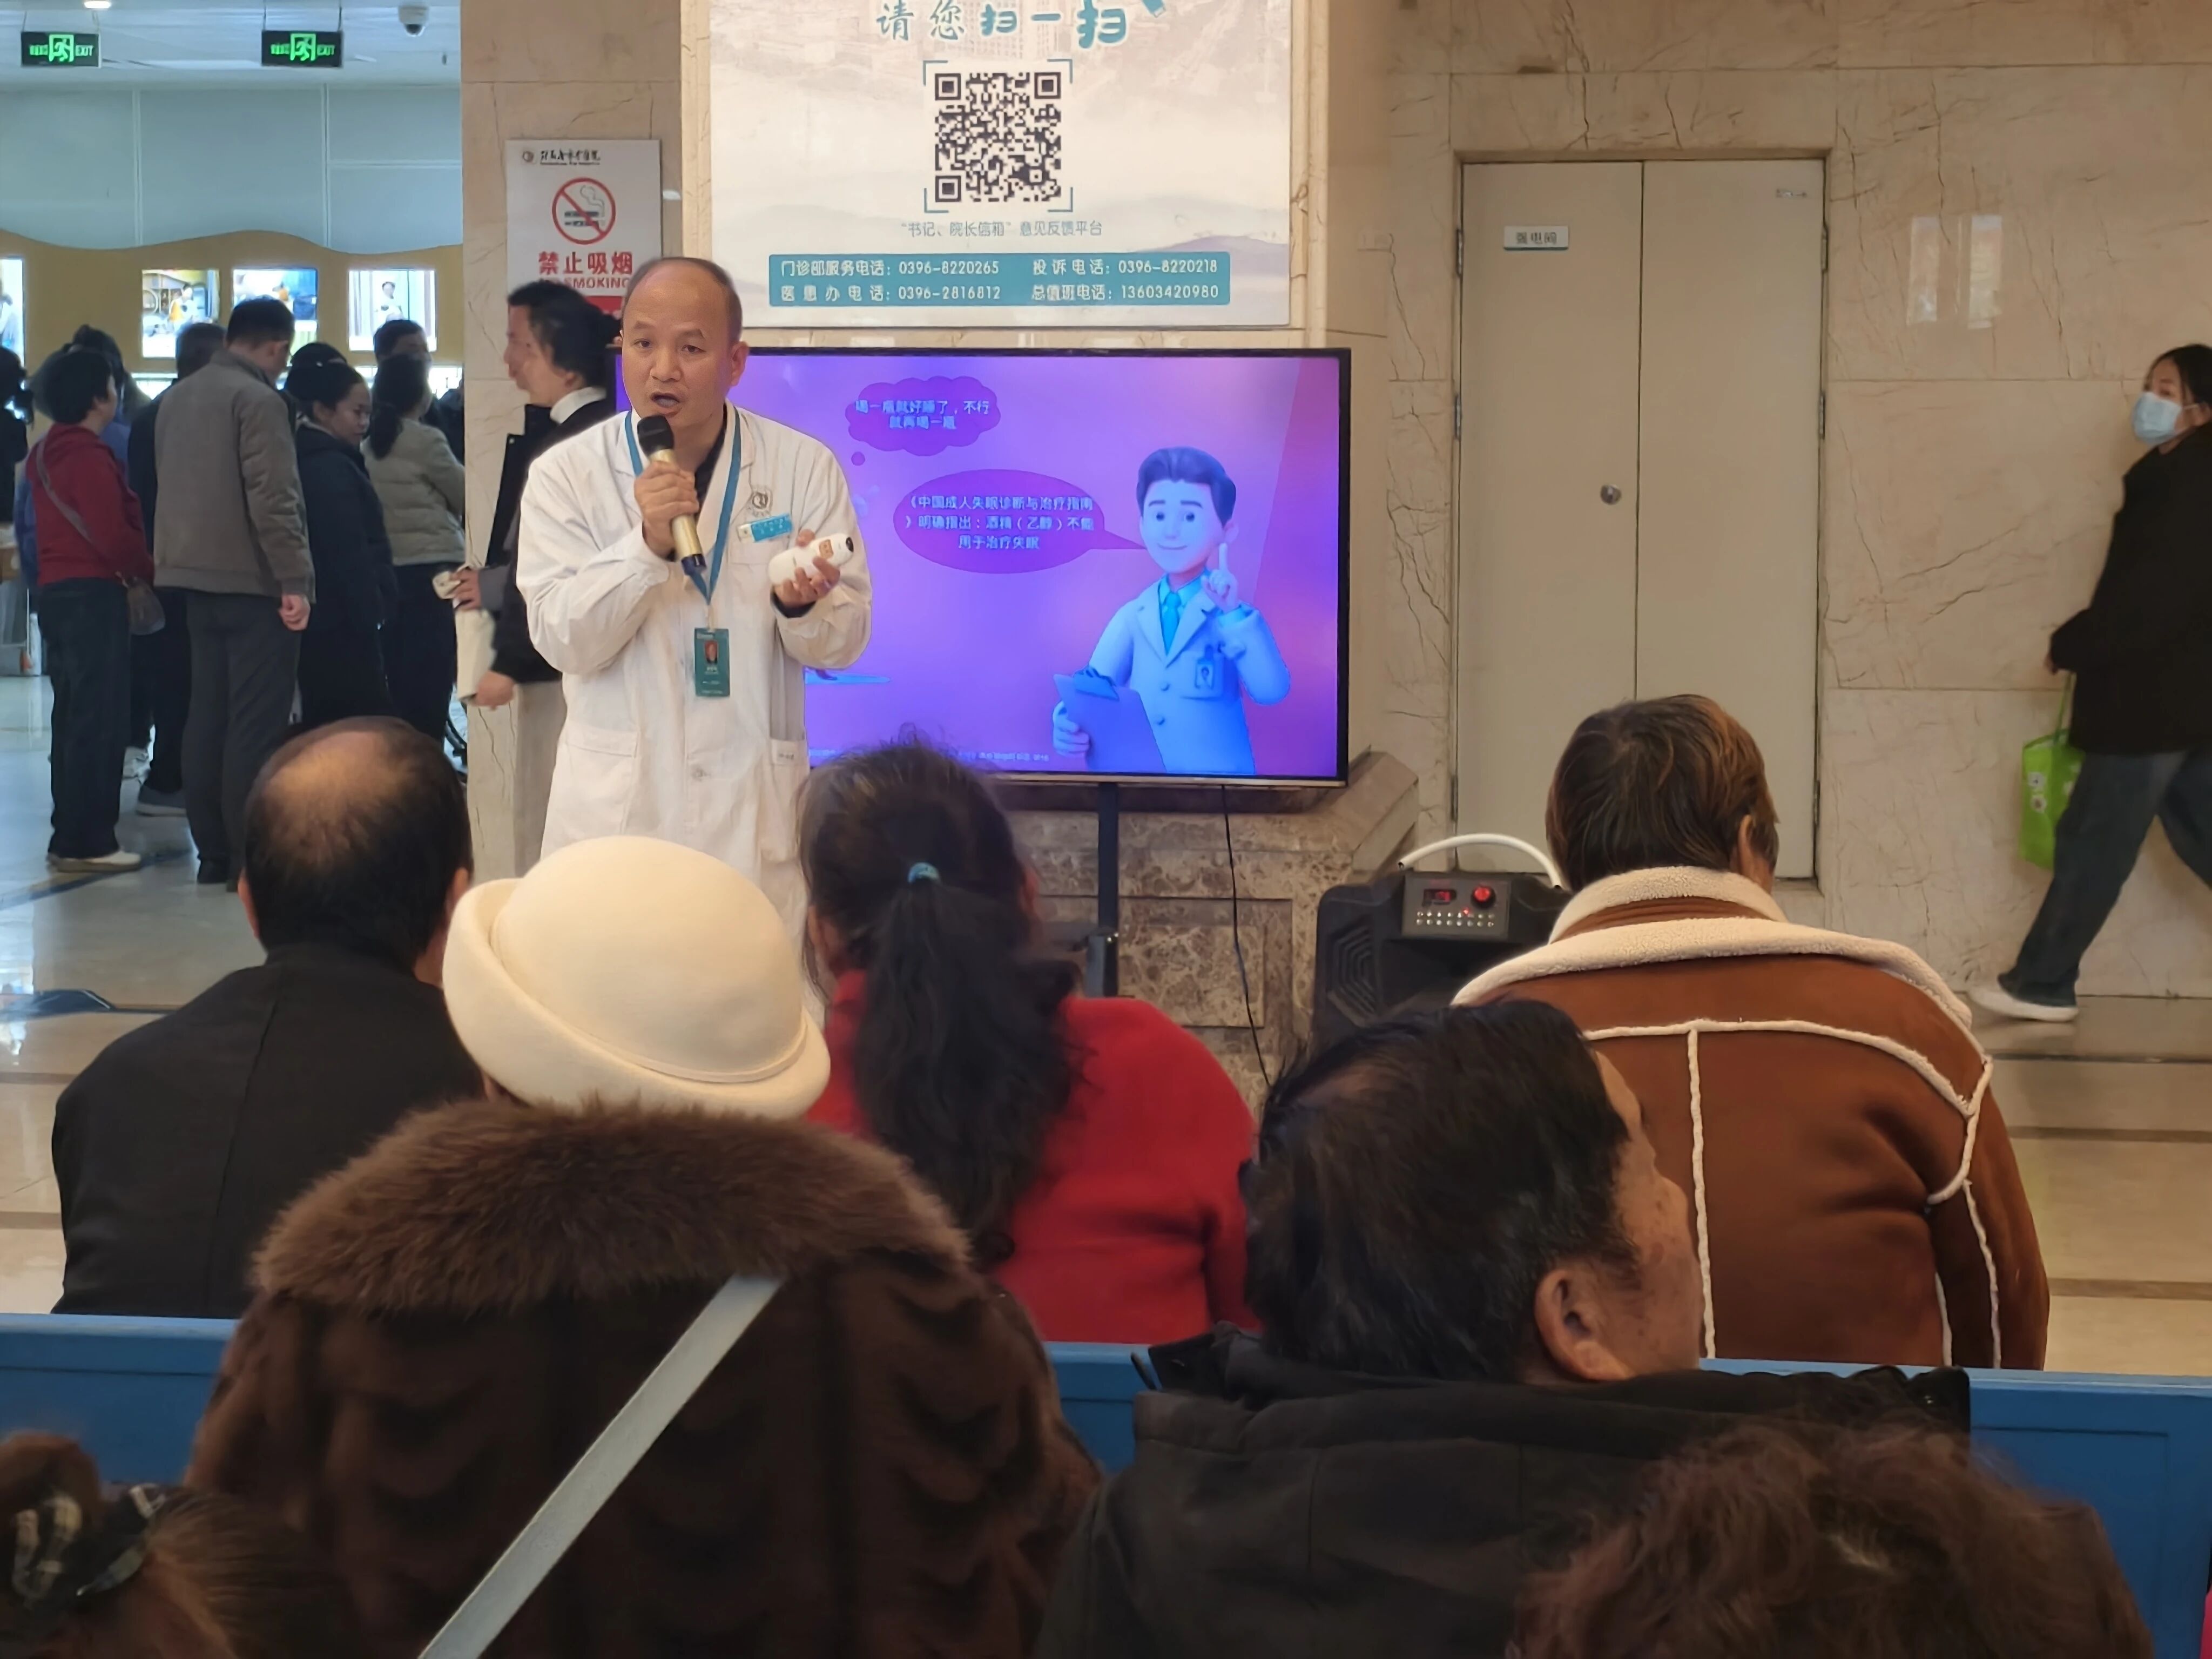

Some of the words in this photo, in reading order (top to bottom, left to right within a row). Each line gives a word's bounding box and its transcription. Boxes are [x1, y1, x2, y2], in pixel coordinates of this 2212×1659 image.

[876, 0, 1127, 48] 请您扫一扫
[538, 251, 632, 274] 禁止吸烟
[898, 260, 1000, 275] 0396-8220265
[1118, 259, 1217, 274] 0396-8220218
[898, 286, 1001, 300] 0396-2816812
[1121, 285, 1219, 299] 13603420980
